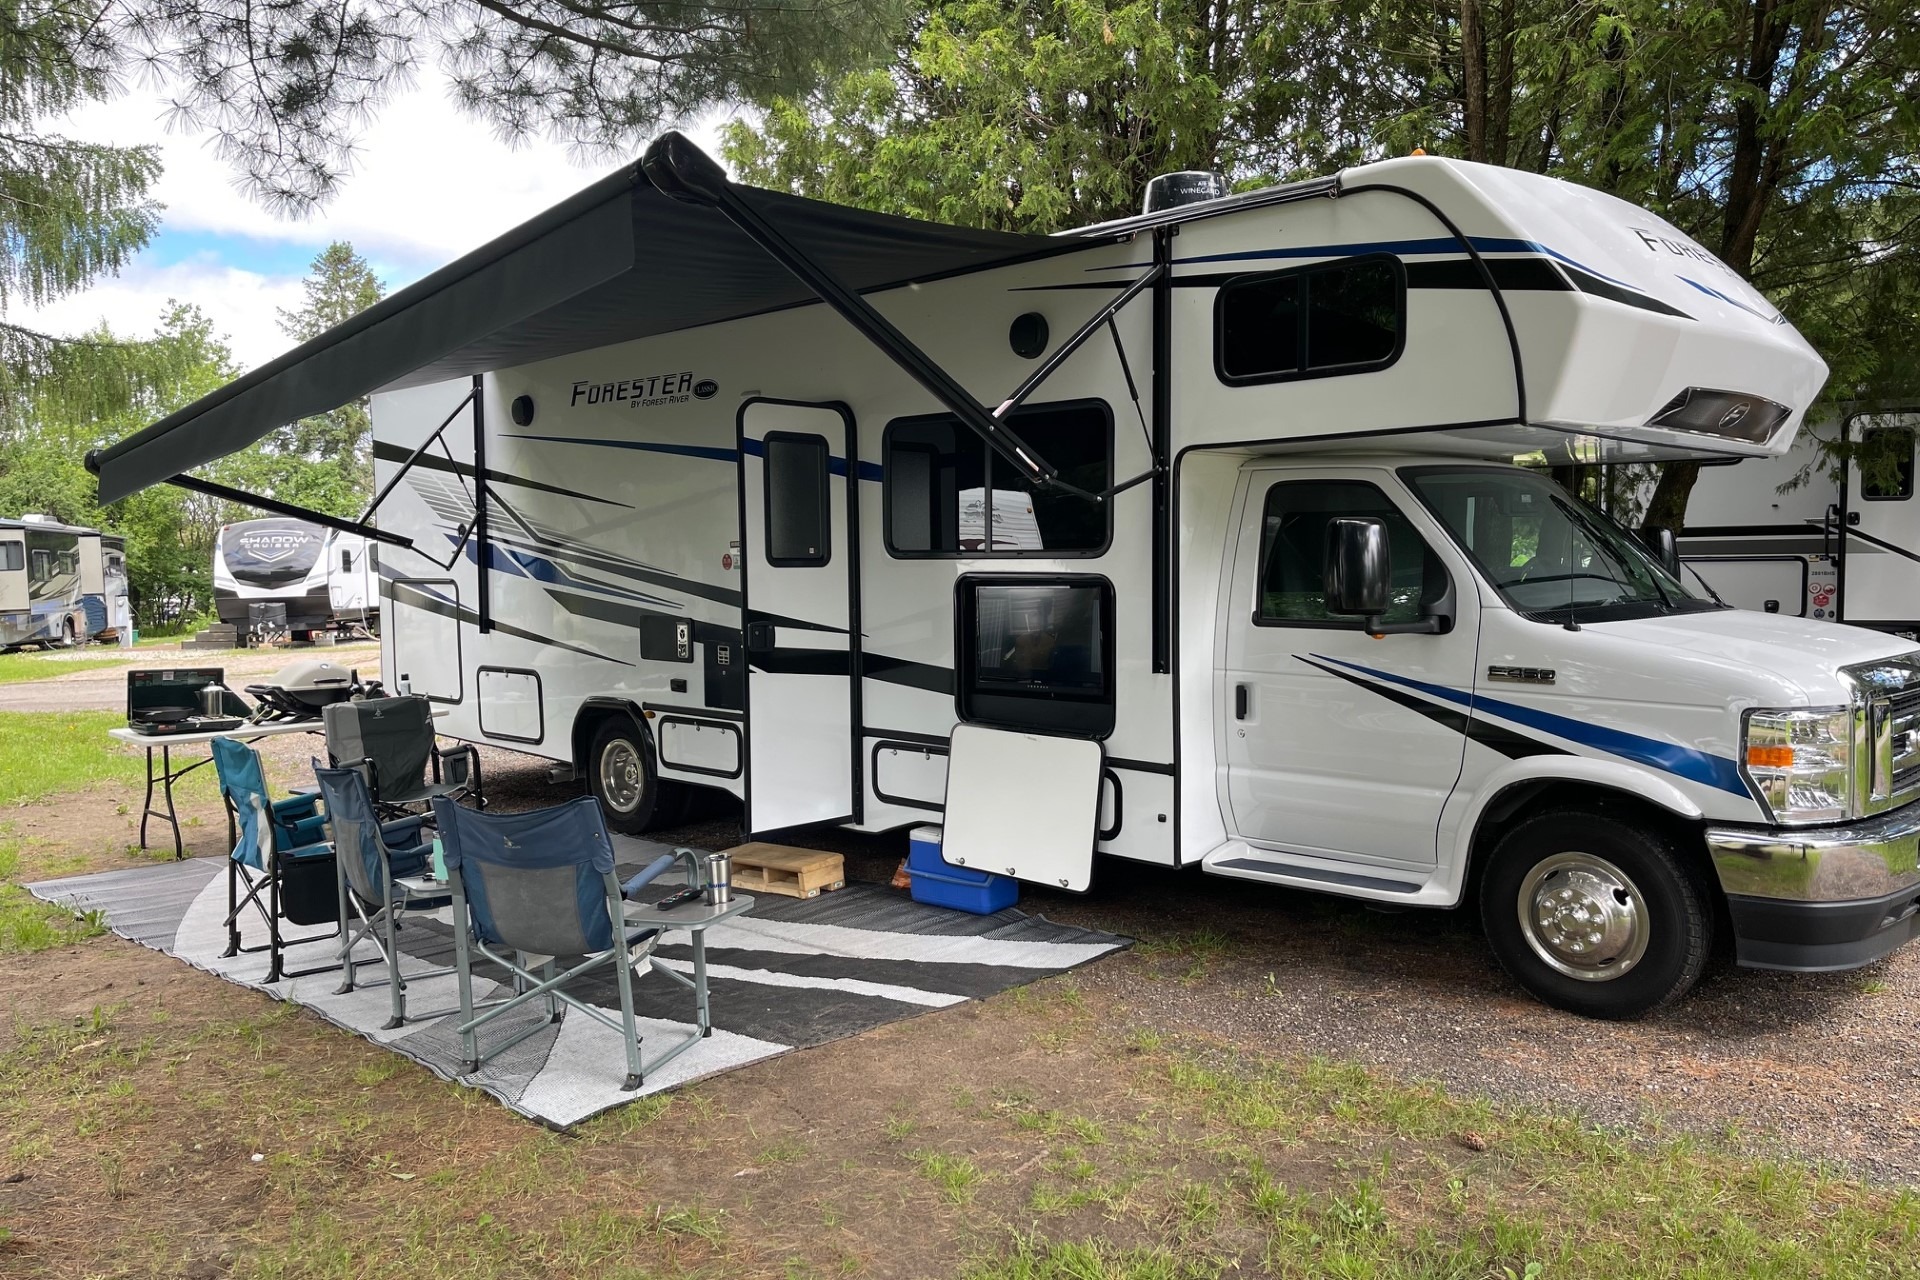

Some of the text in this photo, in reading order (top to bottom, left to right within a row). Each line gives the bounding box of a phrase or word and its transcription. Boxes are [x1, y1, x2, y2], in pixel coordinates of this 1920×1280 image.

[571, 371, 693, 407] FORESTER
[631, 395, 690, 409] BY FOREST RIVER
[240, 536, 309, 544] SHADOW
